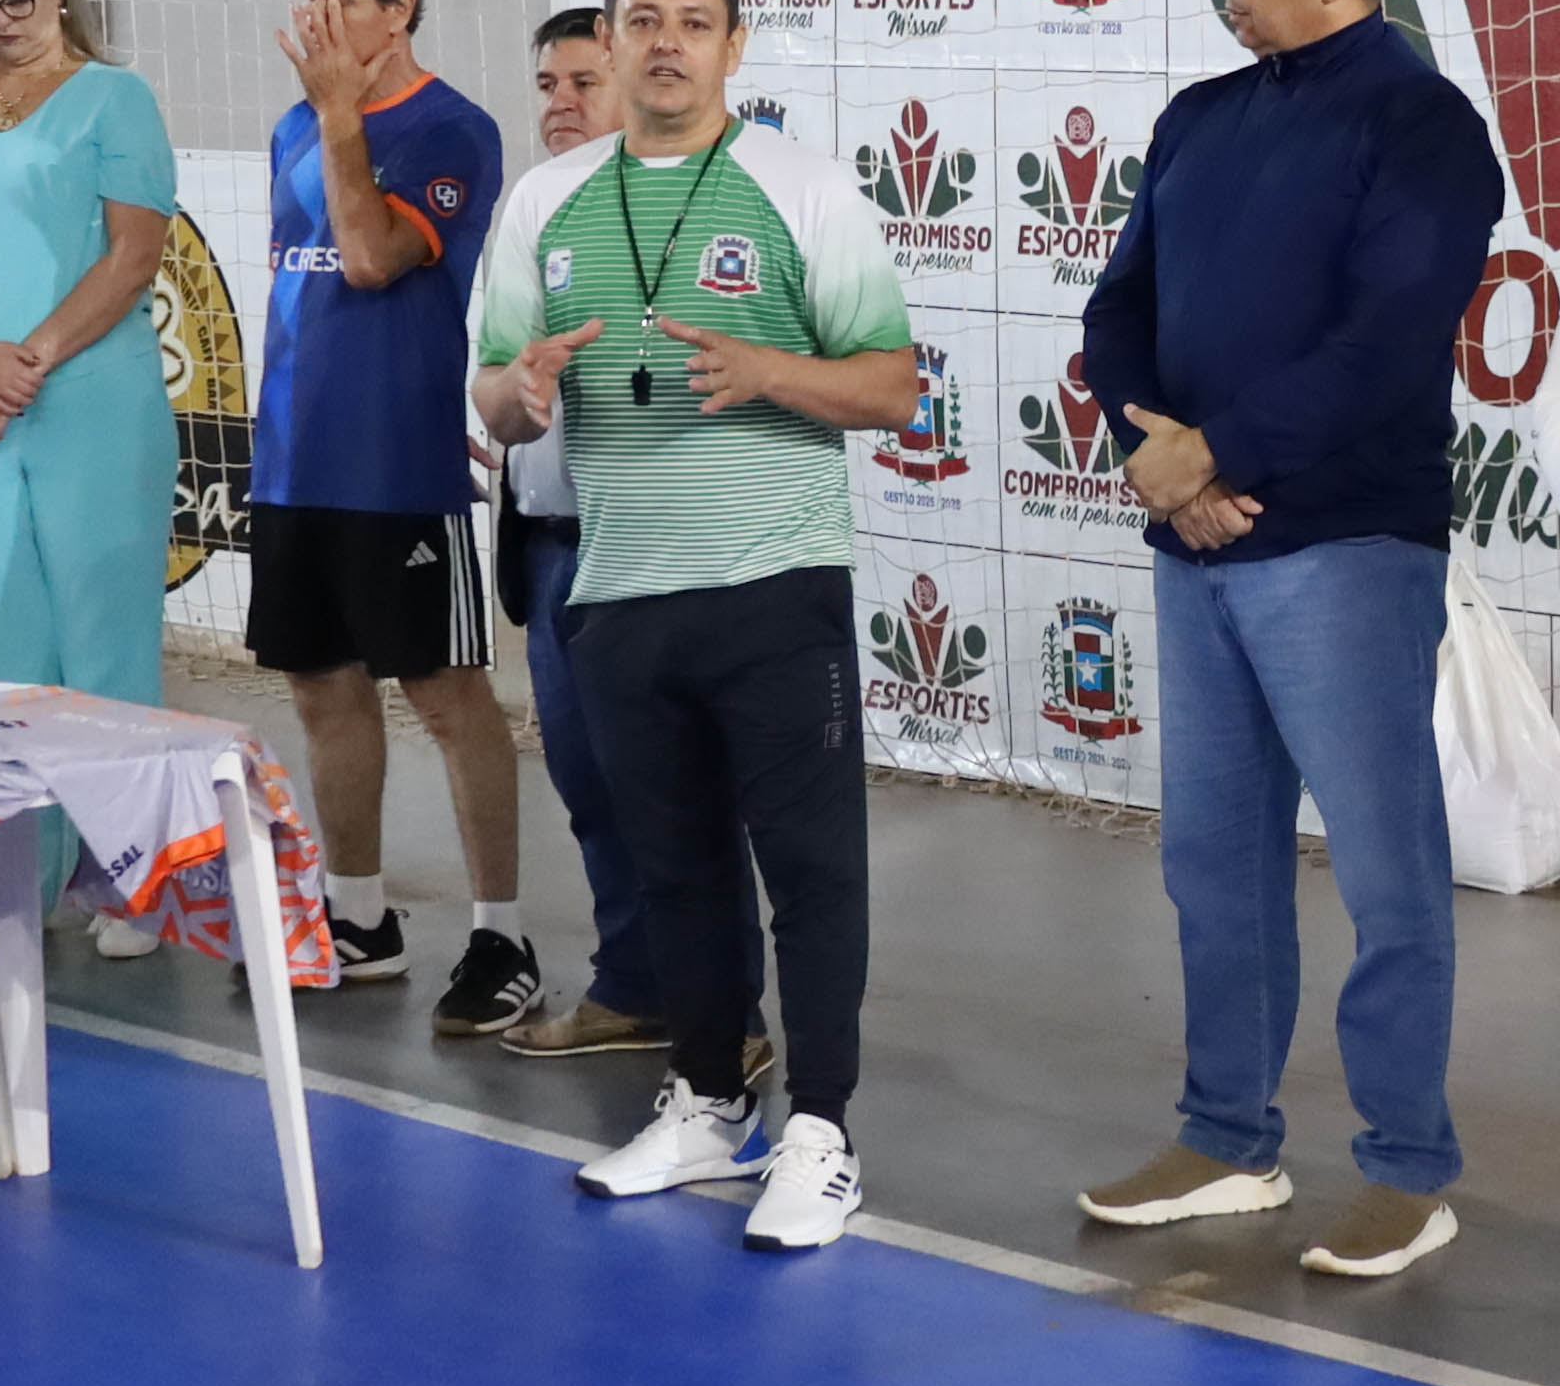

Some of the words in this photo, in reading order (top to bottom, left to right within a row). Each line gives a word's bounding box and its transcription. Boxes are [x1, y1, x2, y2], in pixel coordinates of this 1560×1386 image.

[753, 9, 814, 35] pessoas
[887, 11, 948, 37] Missal
[1076, 20, 1095, 35] 202
[882, 223, 991, 252] PROMISSO
[1017, 224, 1121, 260] ESPORT
[283, 245, 345, 273] CRES
[893, 250, 911, 268] as
[911, 249, 973, 276] pessoas
[1051, 257, 1100, 287] Miss
[1004, 469, 1143, 507] COMPROMIS
[1021, 498, 1058, 518] com
[863, 678, 990, 725] ESPORTES
[899, 712, 961, 746] Missal
